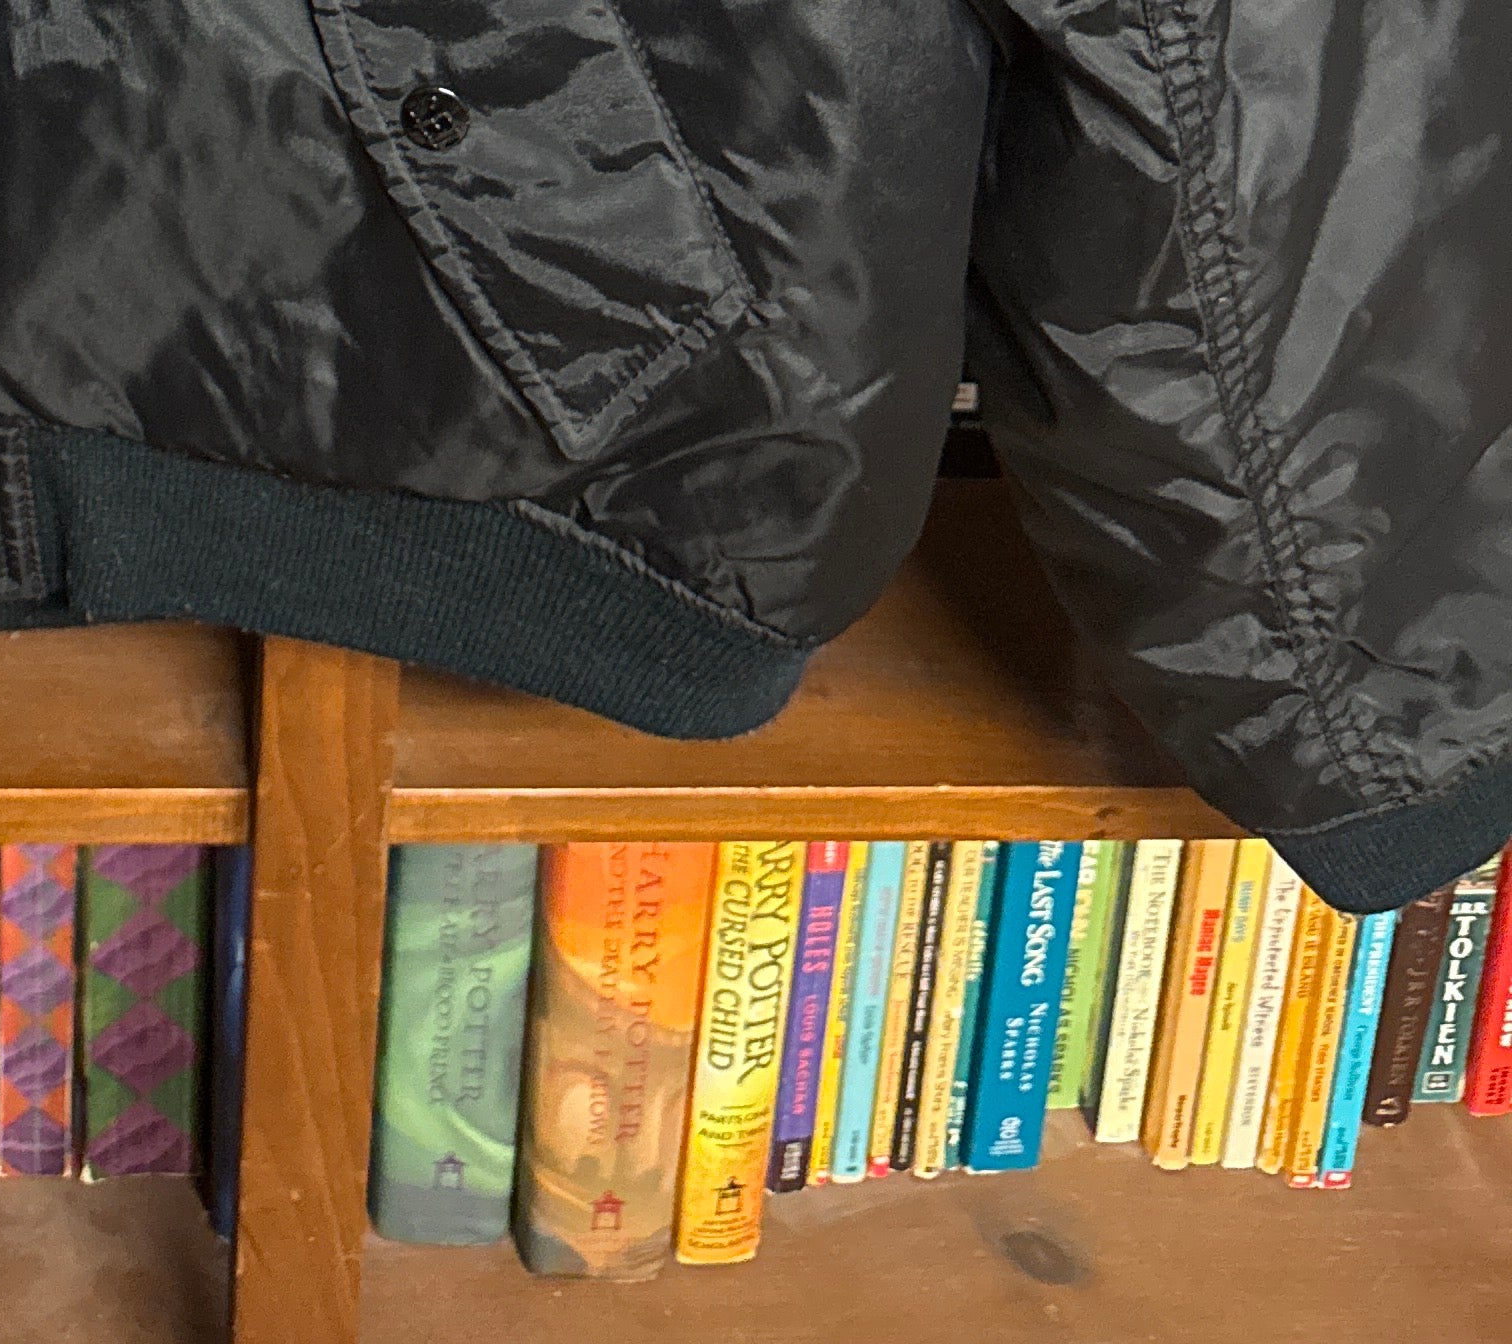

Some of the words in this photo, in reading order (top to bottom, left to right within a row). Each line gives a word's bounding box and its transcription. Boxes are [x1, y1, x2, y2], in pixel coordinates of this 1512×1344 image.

[715, 882, 752, 981] CURSED
[801, 904, 834, 976] HOLES
[1029, 868, 1064, 921] LAST
[1020, 922, 1057, 988] SONG
[1431, 914, 1478, 1066] TOLKIEN
[707, 987, 741, 1071] CHILD
[736, 934, 791, 1087] POTTER
[614, 998, 653, 1145] POTTER
